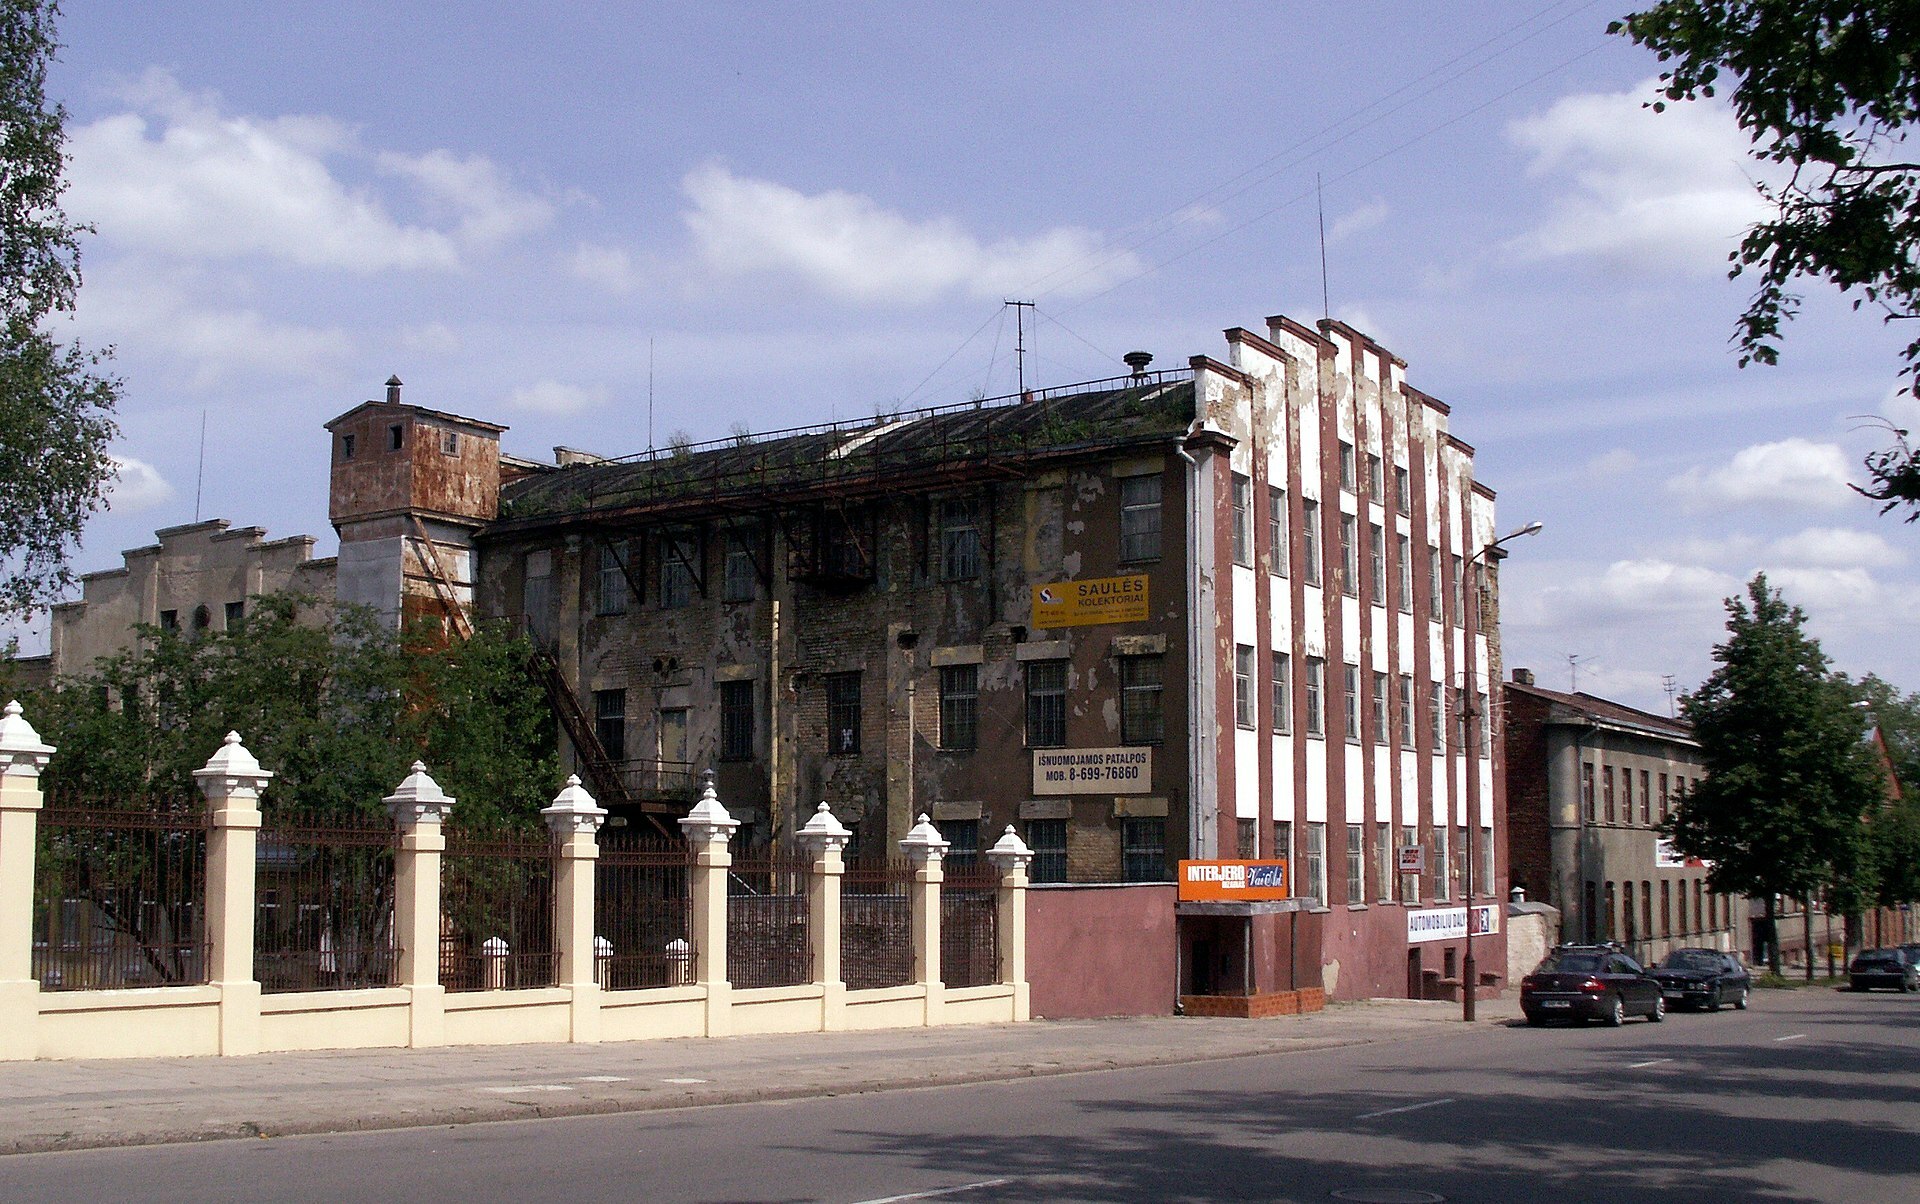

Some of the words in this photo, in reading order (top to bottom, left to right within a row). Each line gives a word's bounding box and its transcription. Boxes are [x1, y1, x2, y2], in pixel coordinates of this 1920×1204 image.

[1078, 578, 1143, 596] SAULĖS
[1078, 595, 1145, 607] KOLEKTORIAI
[1039, 753, 1103, 766] IŠNUOMOJAMOS
[1106, 753, 1146, 764] PATALPOS
[1046, 771, 1067, 781] MOB.
[1069, 766, 1138, 780] 8-699-76860
[1187, 865, 1245, 881] INTERJERO
